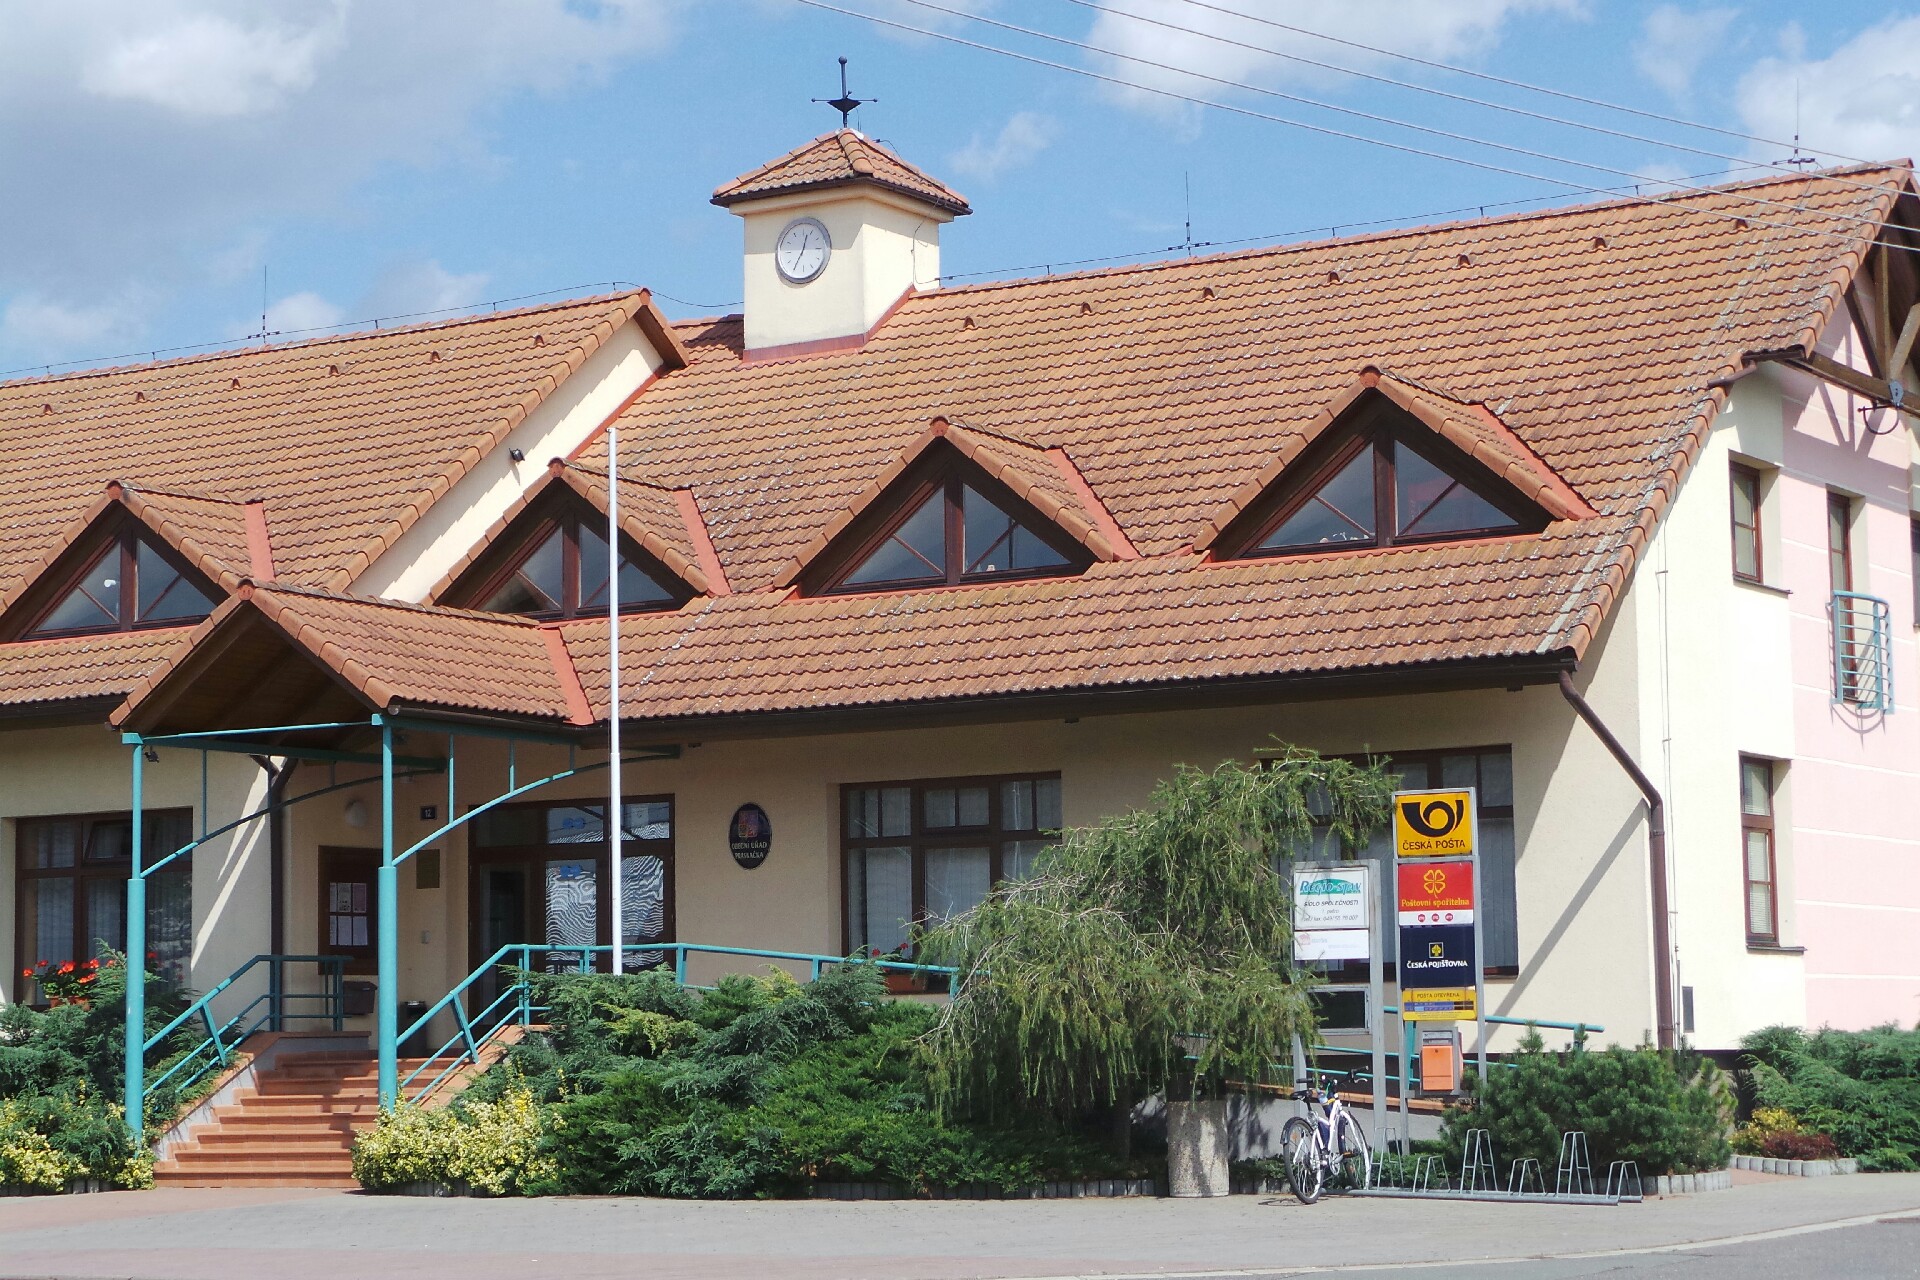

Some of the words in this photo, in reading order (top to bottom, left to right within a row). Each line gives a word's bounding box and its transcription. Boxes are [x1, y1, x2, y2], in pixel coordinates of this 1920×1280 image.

[424, 808, 432, 818] 12
[1402, 839, 1432, 850] ČESKÁ
[1436, 838, 1466, 848] POŠTA
[1402, 899, 1431, 907] Poštovní
[1433, 898, 1470, 907] spořitelna
[1406, 960, 1428, 968] ČESKÁ
[1429, 960, 1468, 968] POJIŠŤOVNA
